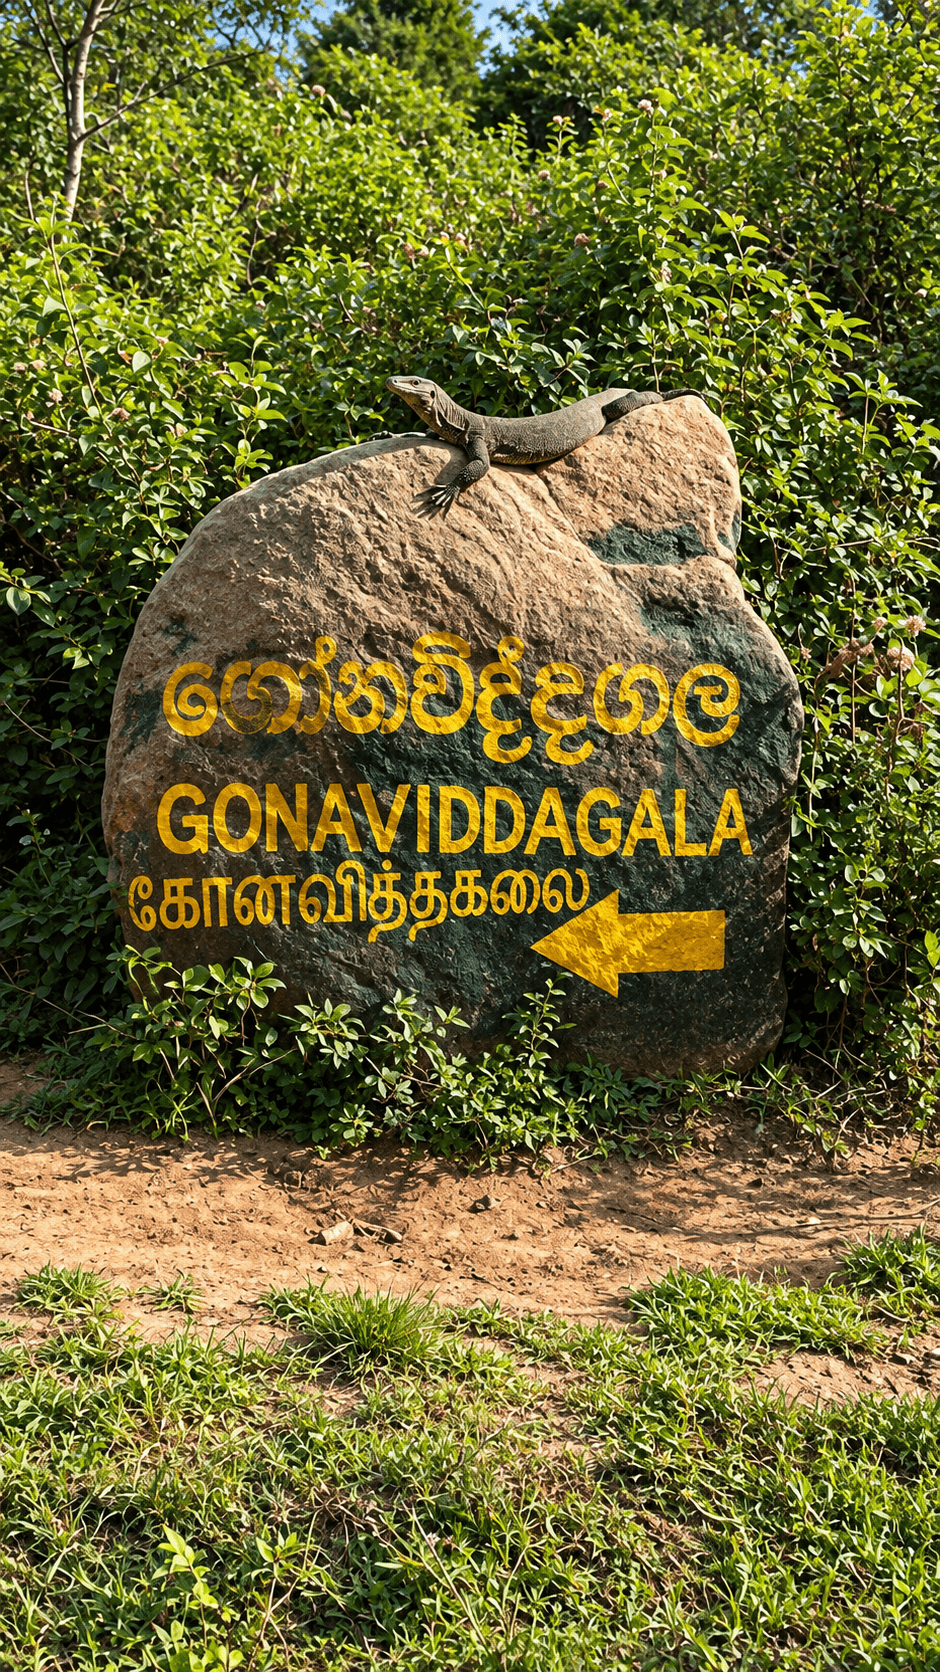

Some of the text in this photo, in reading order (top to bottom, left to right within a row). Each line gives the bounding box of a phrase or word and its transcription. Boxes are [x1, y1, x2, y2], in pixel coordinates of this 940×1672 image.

[162, 631, 741, 766] ගෝනවිද්දගල
[156, 782, 754, 857] GONAVIDDAGALA
[127, 859, 591, 944] கோனவித்தகலை
